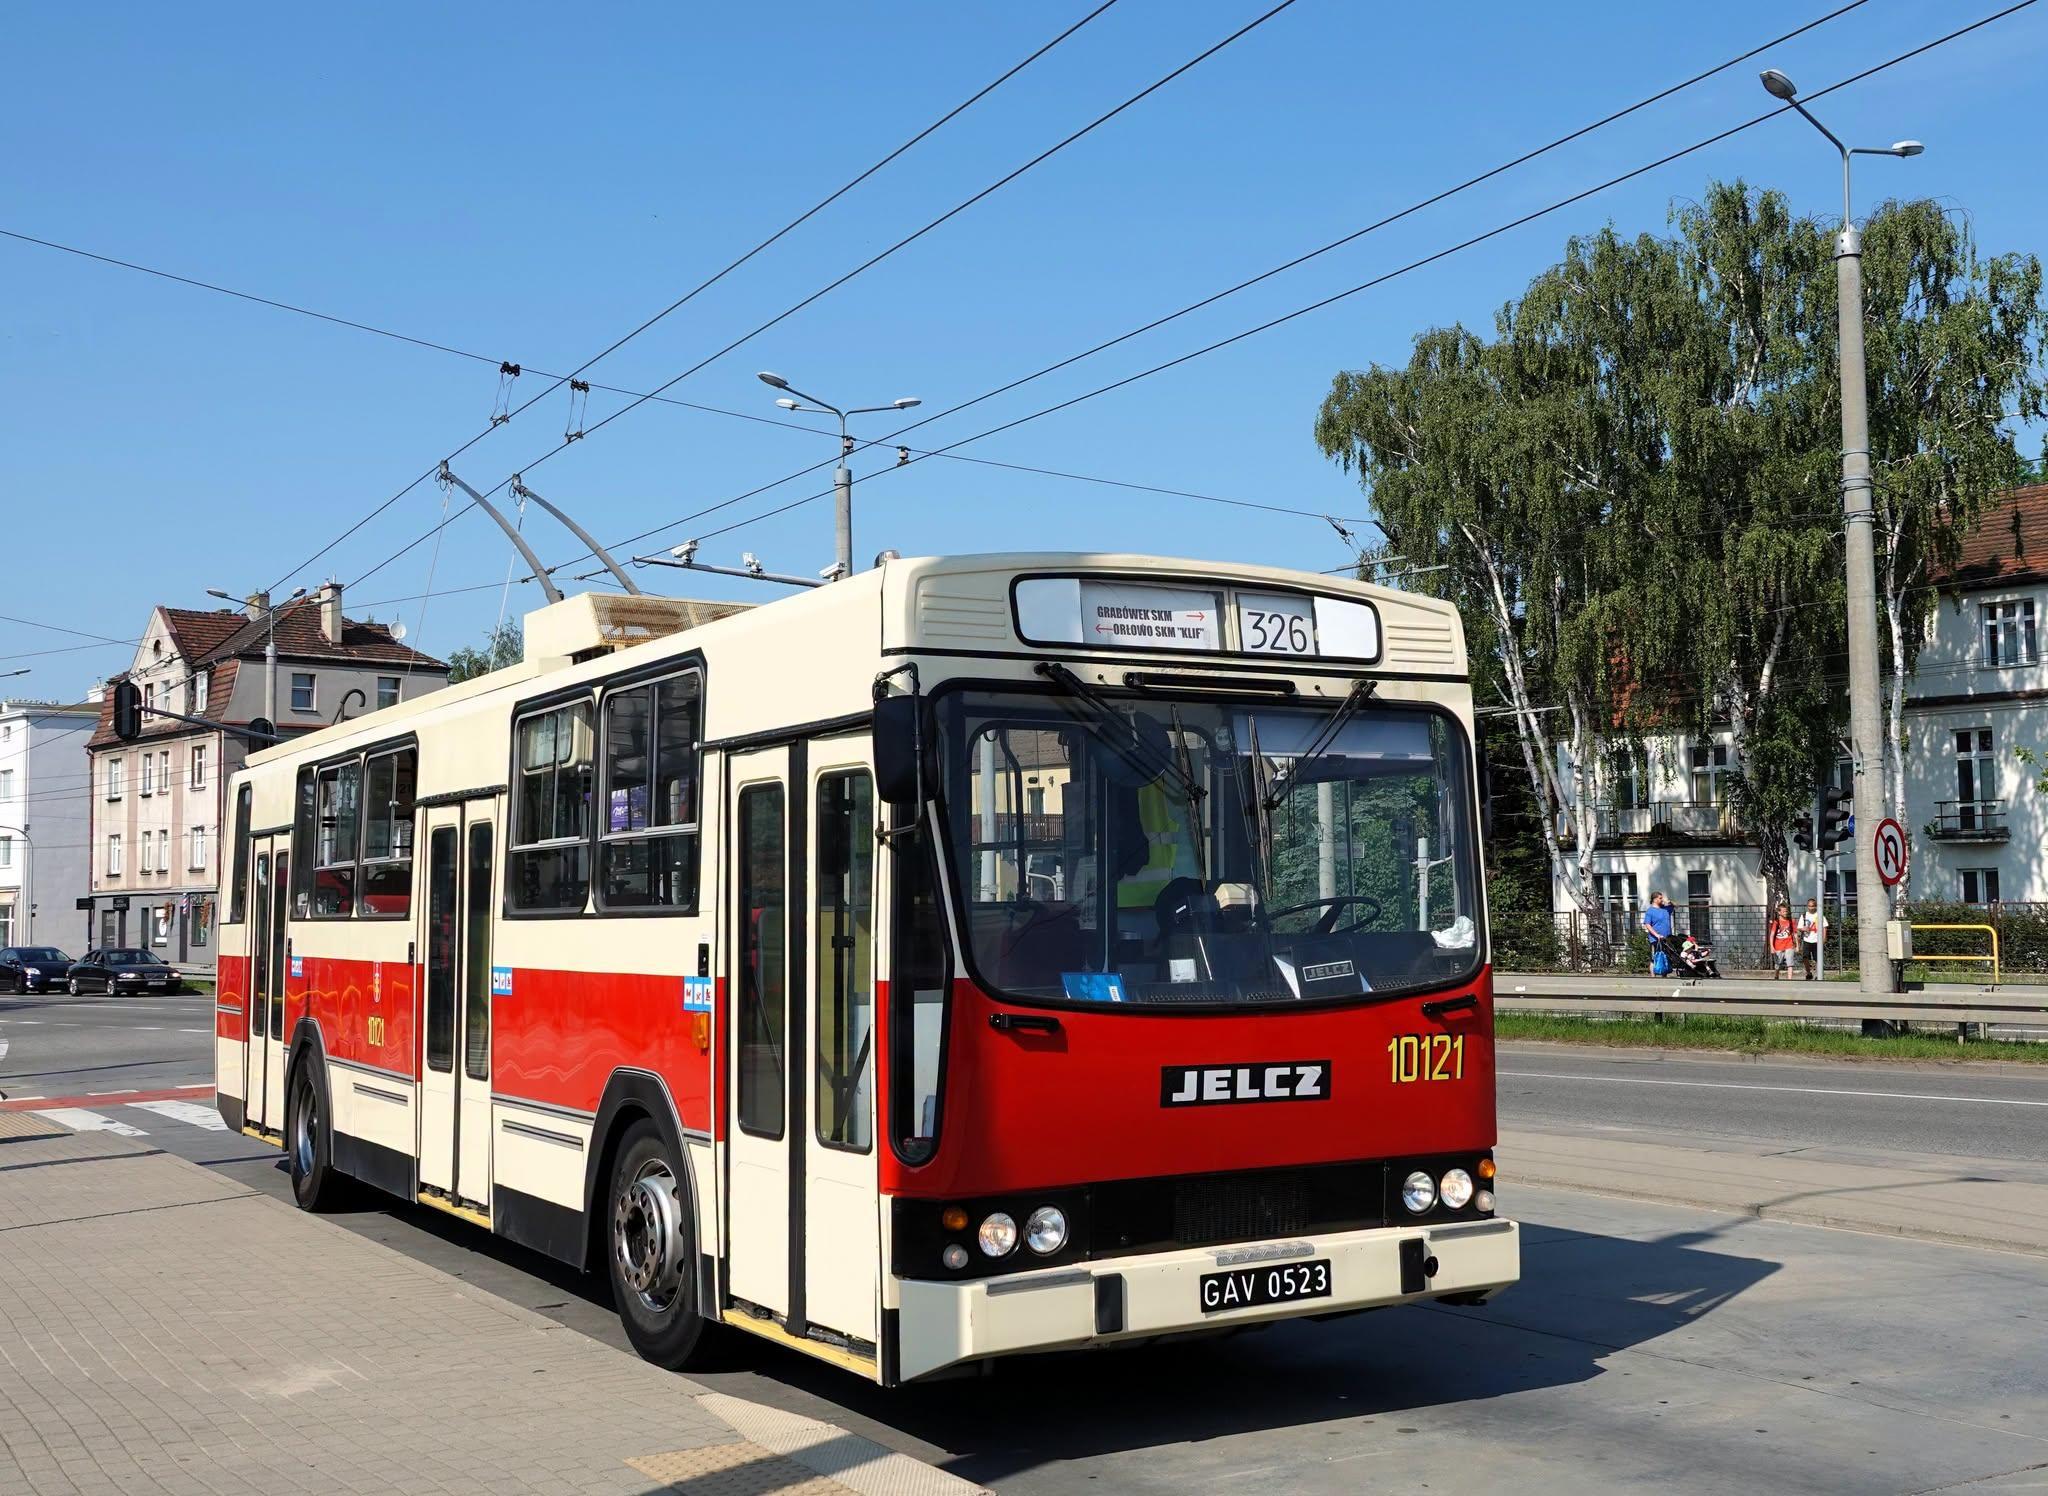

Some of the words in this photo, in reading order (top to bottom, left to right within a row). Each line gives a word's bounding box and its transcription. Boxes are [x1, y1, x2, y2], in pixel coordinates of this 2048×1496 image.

[1097, 606, 1151, 620] GRABÓWEK
[1152, 610, 1173, 622] SKM
[1113, 623, 1154, 637] ORŁOWO
[1155, 625, 1176, 638] SKM
[1247, 611, 1308, 653] 326
[1308, 963, 1351, 978] JELCZ
[368, 1016, 385, 1047] 10121
[1387, 1033, 1465, 1084] 10121
[1171, 1065, 1323, 1102] JELCZ
[1203, 1273, 1256, 1307] GAV
[1266, 1263, 1329, 1299] 0523
